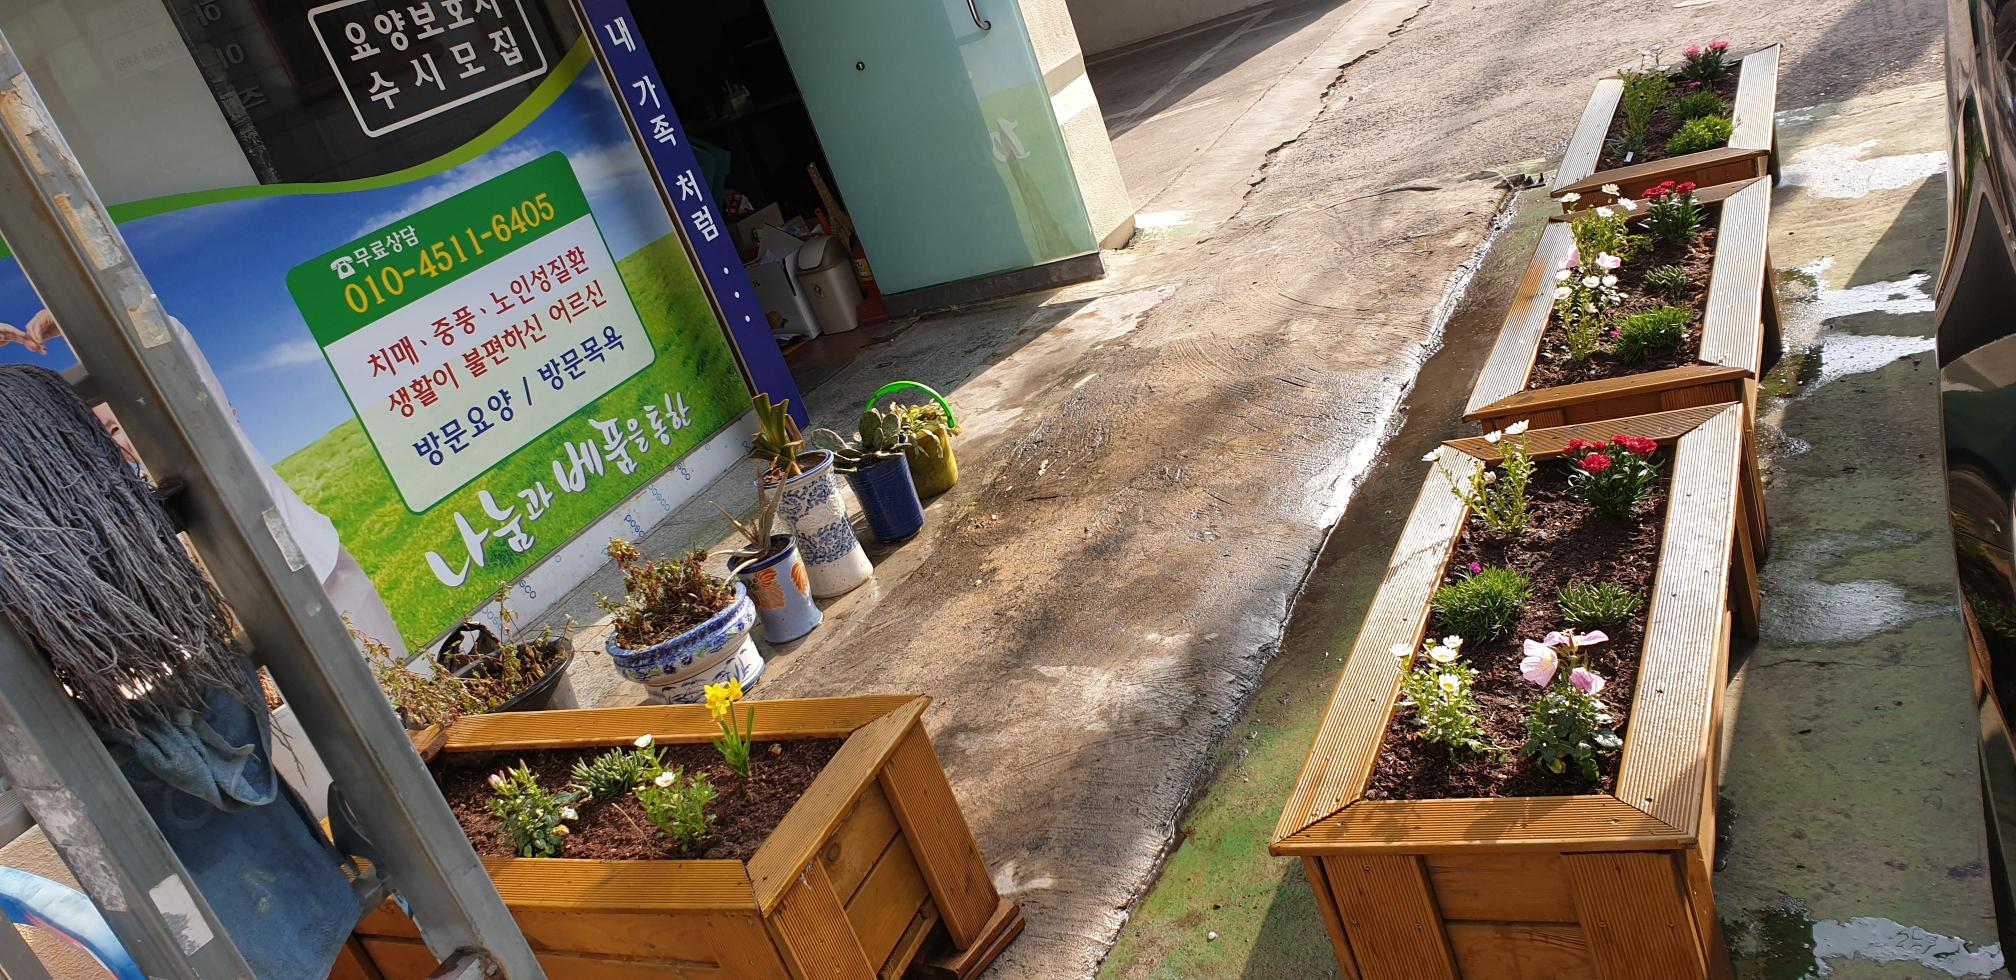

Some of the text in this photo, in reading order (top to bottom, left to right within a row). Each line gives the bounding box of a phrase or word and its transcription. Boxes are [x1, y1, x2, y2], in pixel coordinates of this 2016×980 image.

[604, 16, 637, 53] 내
[344, 193, 556, 314] 010-4511-6405
[352, 225, 420, 269] 무료상담
[489, 246, 590, 315] 노인성질환
[388, 279, 607, 418] 생활이 불편하신 어르신
[412, 388, 514, 466] 방문요양
[537, 325, 625, 391] 방문목욕
[425, 481, 554, 587] 나눔과
